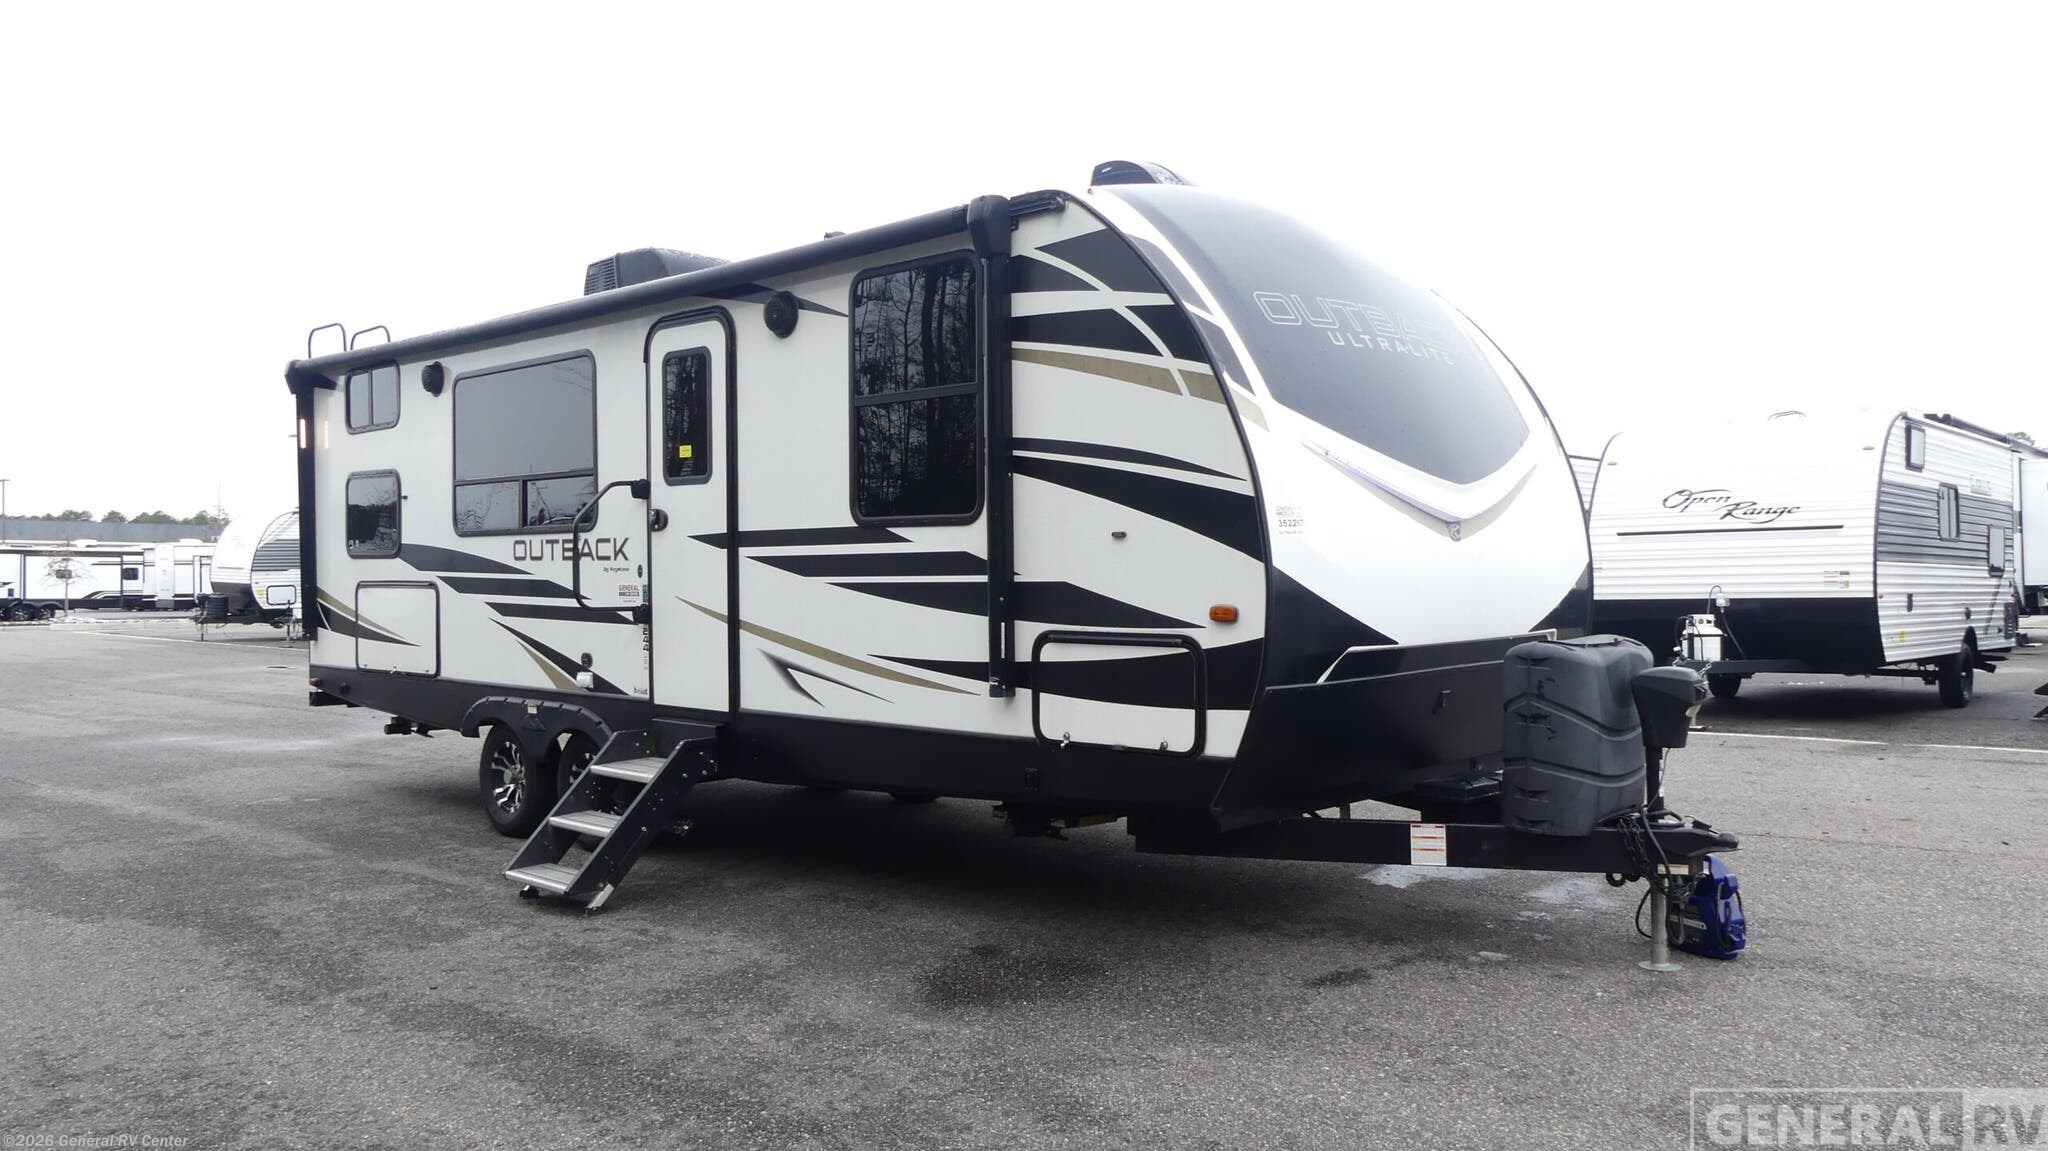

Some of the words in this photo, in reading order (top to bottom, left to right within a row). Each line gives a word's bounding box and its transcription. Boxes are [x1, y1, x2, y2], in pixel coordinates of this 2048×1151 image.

[1662, 489, 1731, 513] Open
[1711, 501, 1801, 524] Range
[513, 537, 629, 561] OUTBACK
